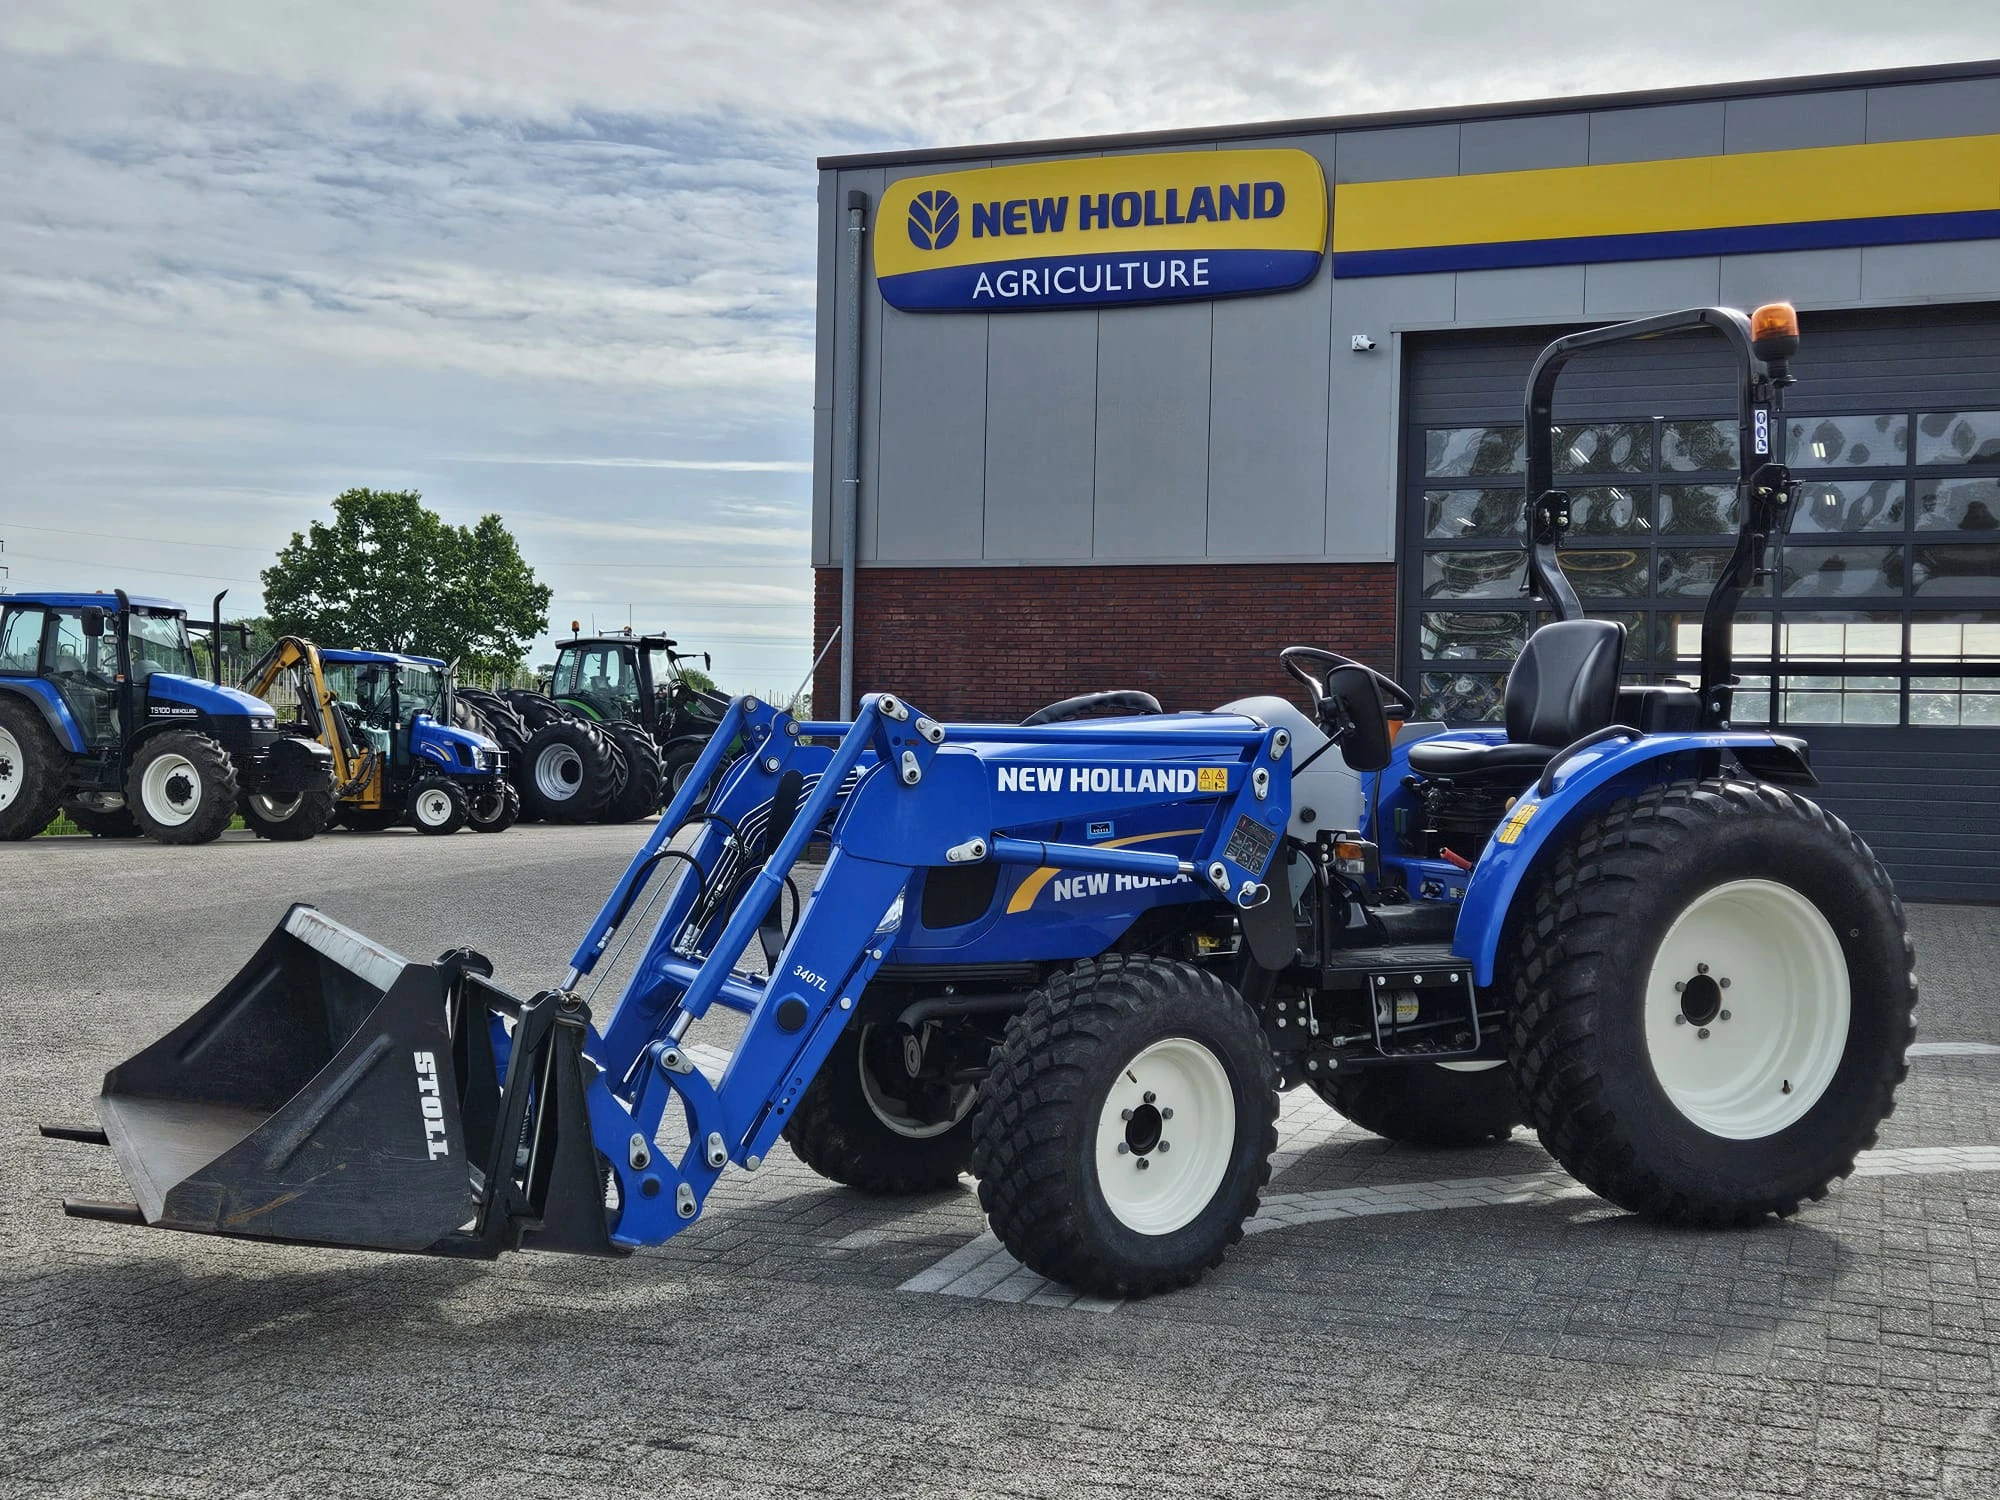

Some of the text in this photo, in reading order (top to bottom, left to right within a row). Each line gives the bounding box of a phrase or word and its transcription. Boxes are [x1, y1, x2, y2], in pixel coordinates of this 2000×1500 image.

[972, 180, 1285, 238] NEW HOLLAND
[972, 258, 1209, 299] AGRICULTURE
[150, 706, 170, 714] TS100
[997, 767, 1196, 793] NEW HOLLAND
[1054, 873, 1110, 902] NEW
[793, 965, 827, 992] 340TL
[413, 1051, 449, 1161] STOLL
